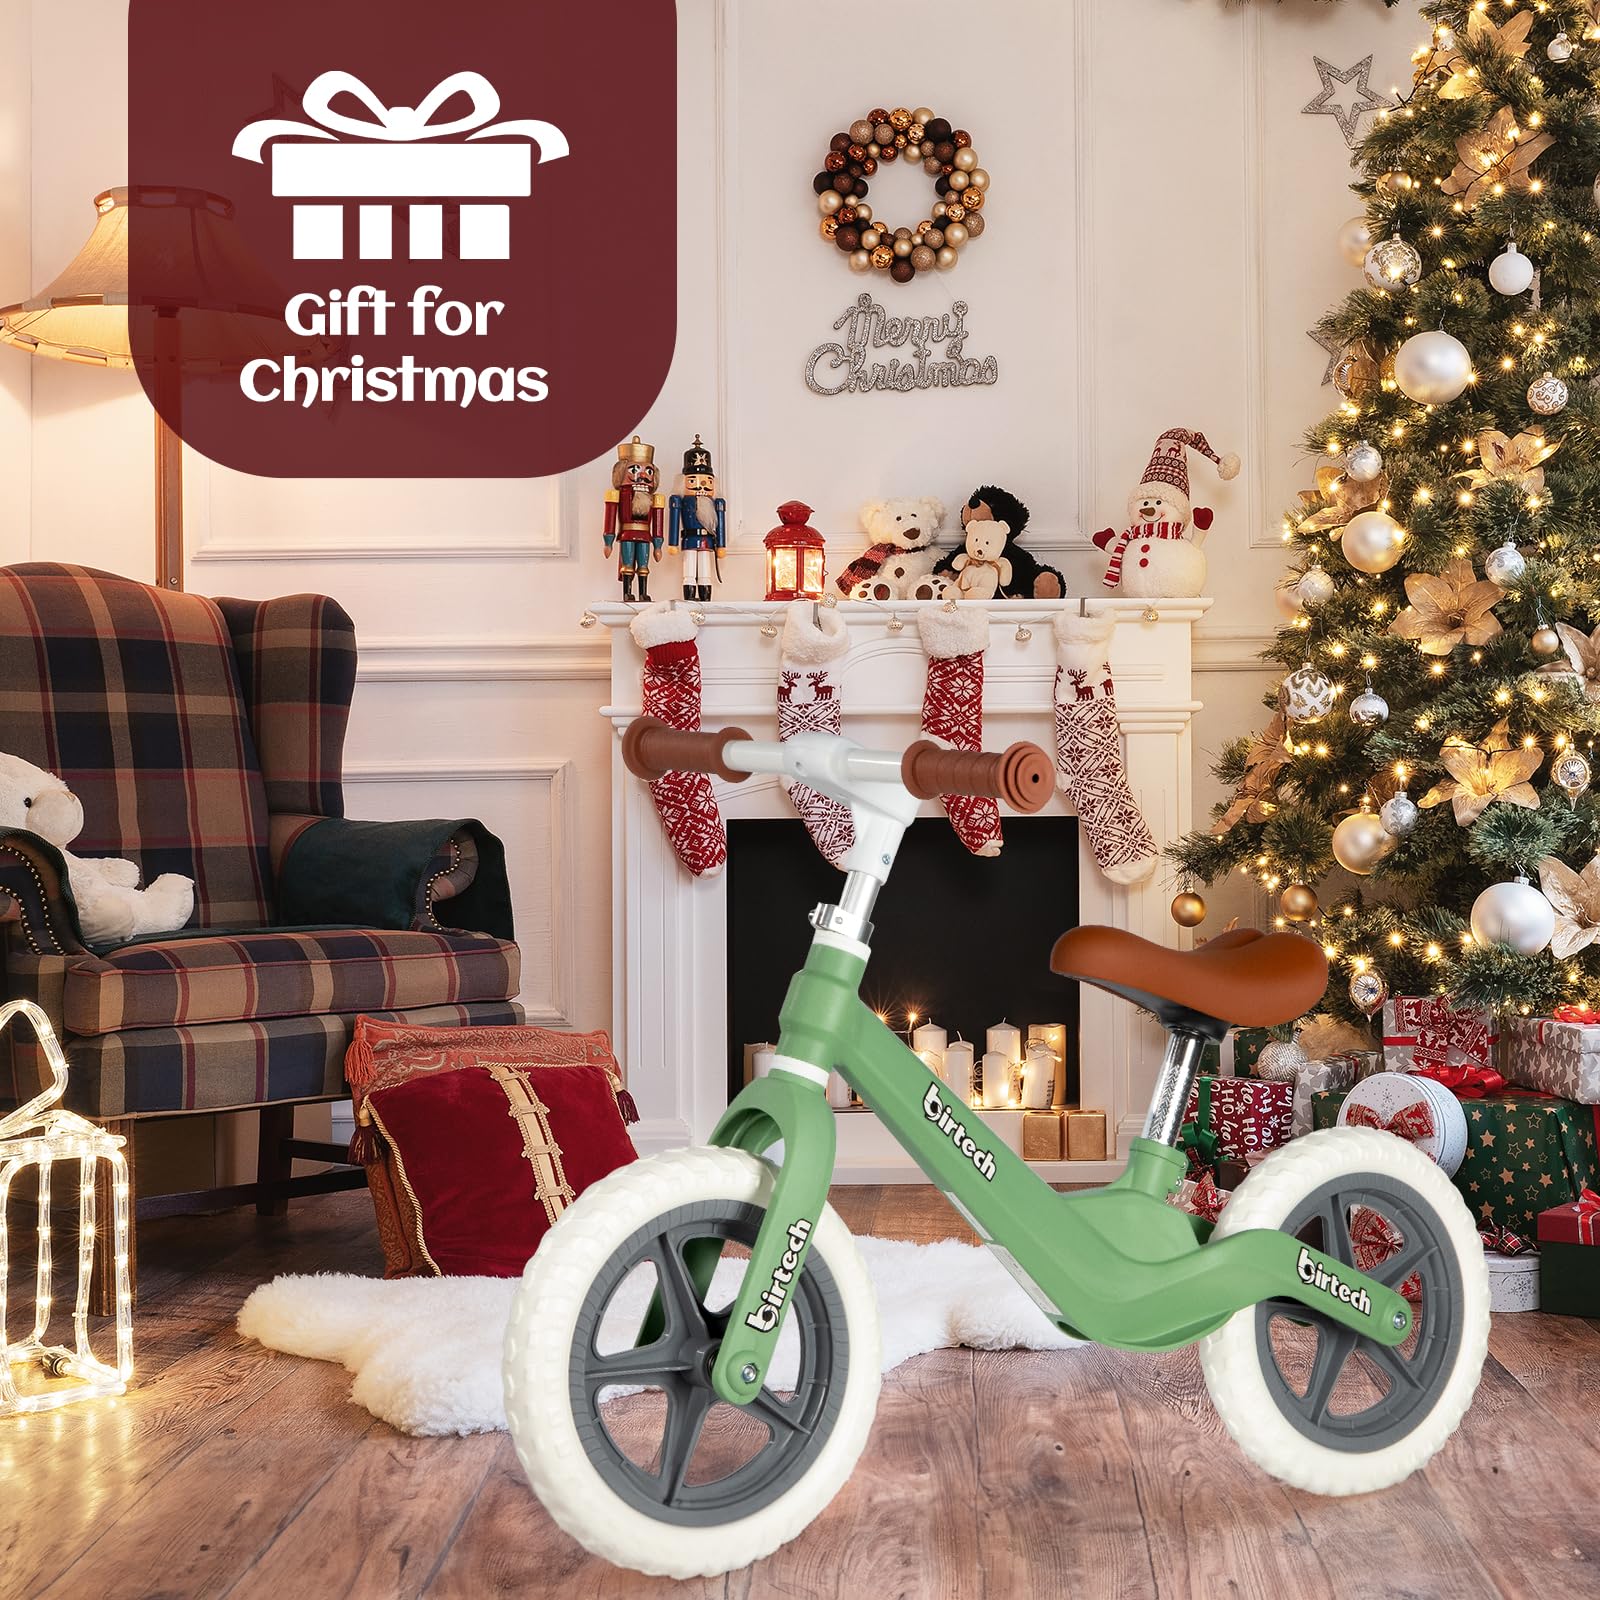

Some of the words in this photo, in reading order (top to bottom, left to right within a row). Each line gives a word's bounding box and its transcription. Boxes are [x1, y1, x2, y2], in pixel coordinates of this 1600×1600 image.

[833, 296, 969, 357] Merry
[805, 342, 999, 395] Christmas
[923, 1081, 997, 1182] birtech
[745, 1218, 813, 1333] birtech
[1297, 1246, 1372, 1317] birtech
